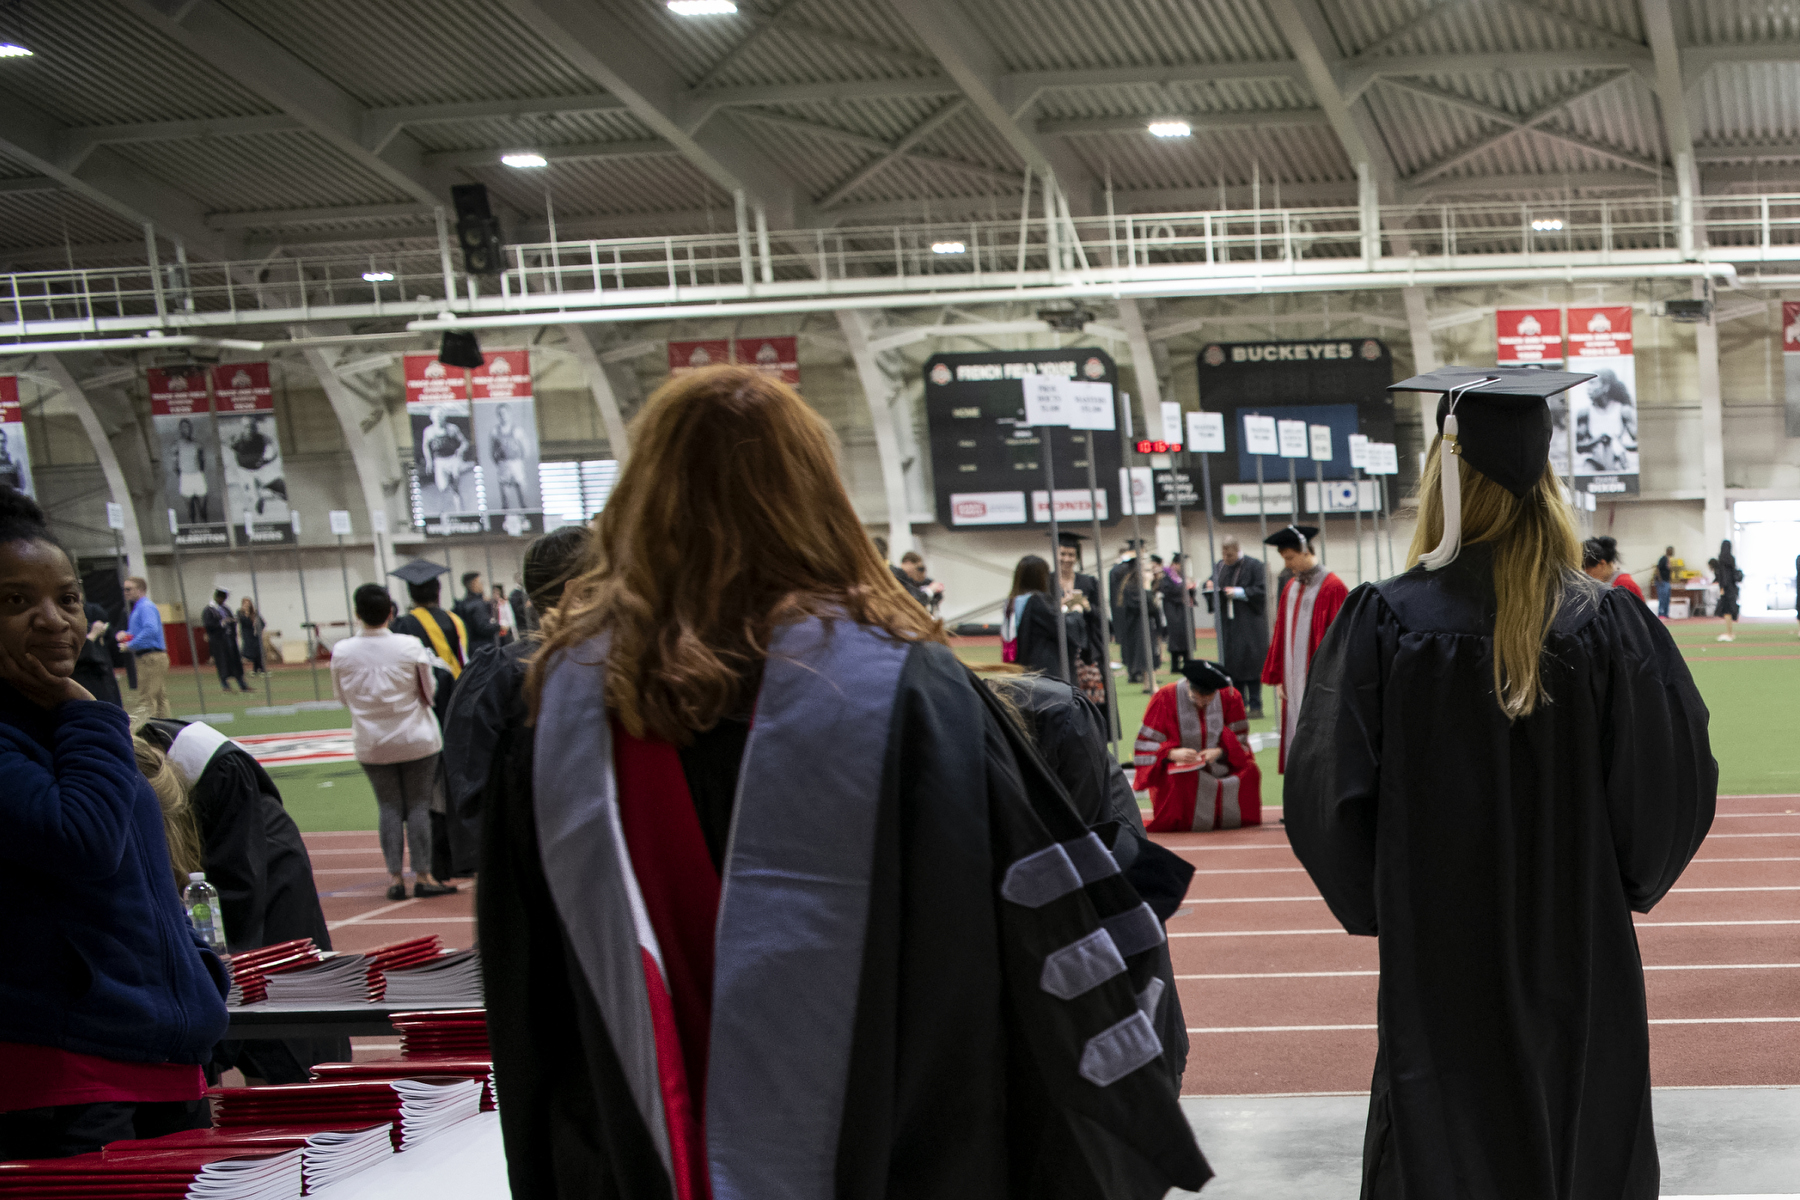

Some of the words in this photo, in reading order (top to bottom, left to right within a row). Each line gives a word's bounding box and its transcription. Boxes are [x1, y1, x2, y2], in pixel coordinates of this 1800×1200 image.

[1231, 343, 1353, 363] BUCKEYES
[955, 364, 1003, 381] FRENCH
[1003, 362, 1037, 379] FIELD
[1037, 361, 1078, 378] HOUSE
[952, 406, 981, 418] HOME
[1038, 500, 1103, 513] HONDA
